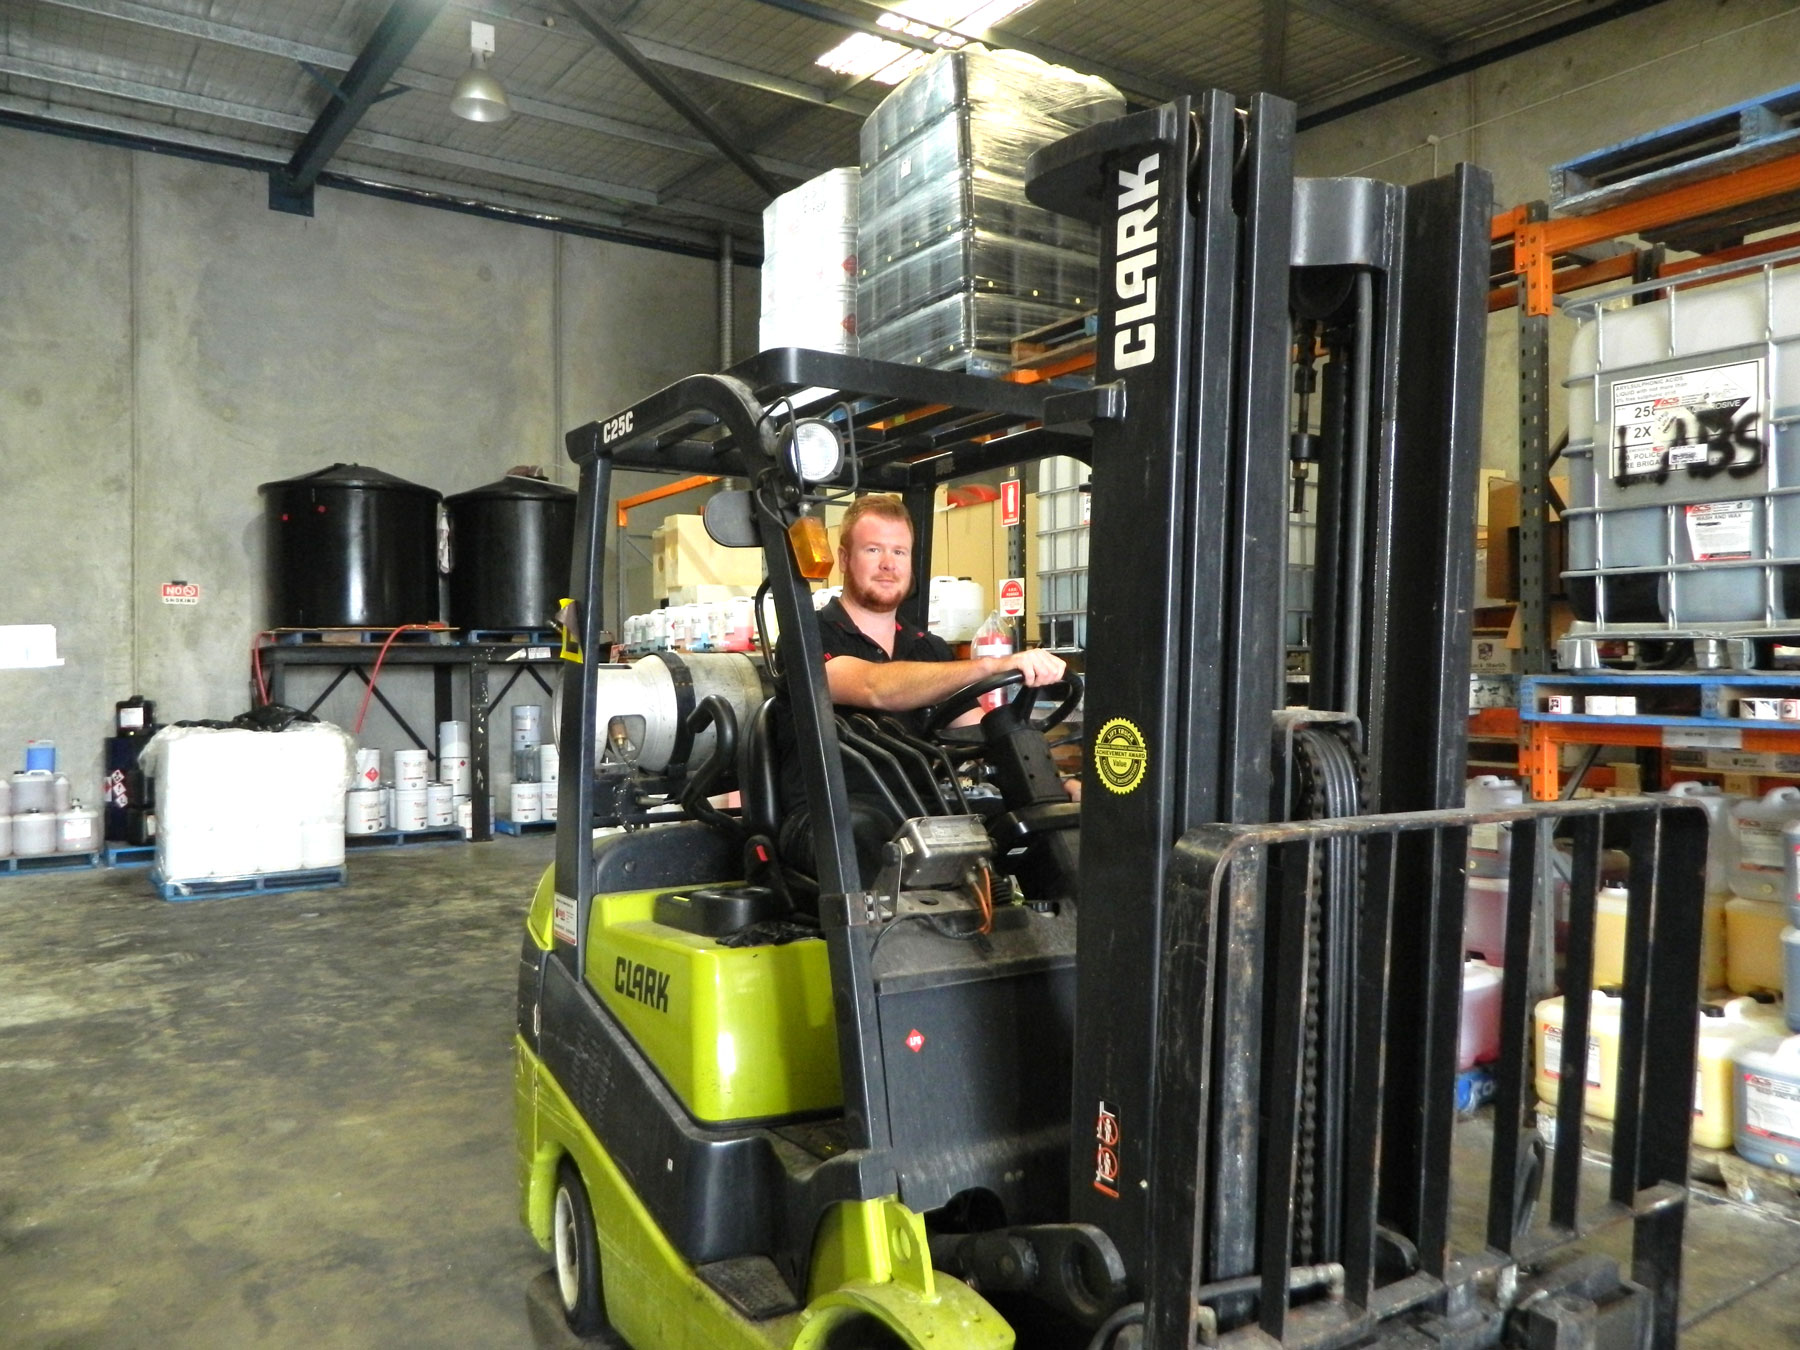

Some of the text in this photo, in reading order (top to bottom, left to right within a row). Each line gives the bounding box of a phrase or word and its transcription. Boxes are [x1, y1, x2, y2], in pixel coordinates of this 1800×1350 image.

[1114, 153, 1160, 371] CLARK
[603, 410, 634, 444] C25C
[1634, 426, 1652, 439] 2X
[1636, 459, 1661, 468] BRIGA
[166, 586, 182, 596] NO
[1096, 749, 1128, 757] ACHIEVEMENT
[615, 955, 671, 1014] CLARK
